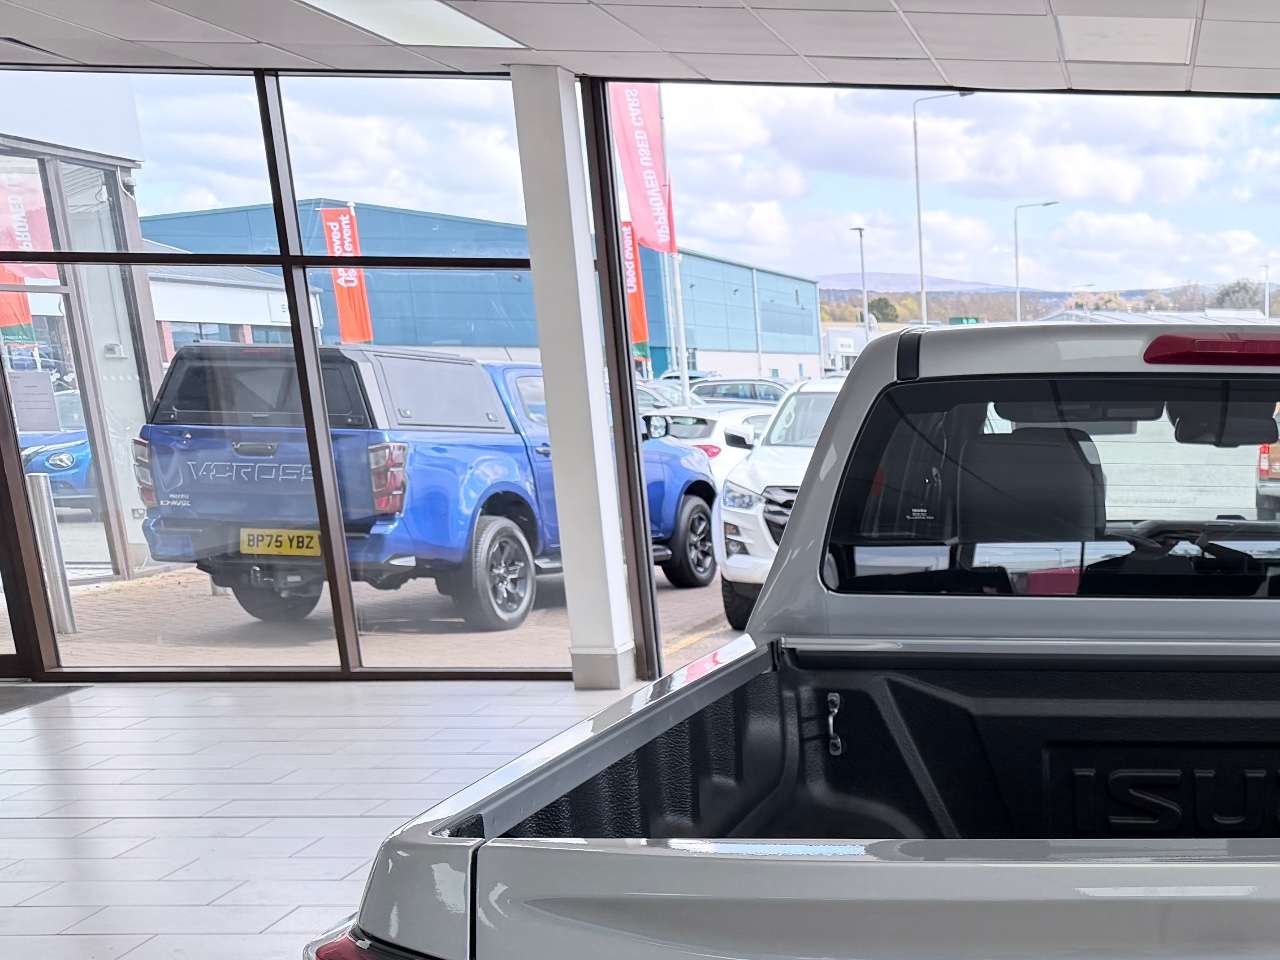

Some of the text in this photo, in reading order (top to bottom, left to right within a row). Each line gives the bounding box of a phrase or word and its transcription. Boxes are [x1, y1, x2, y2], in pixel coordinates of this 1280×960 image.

[339, 213, 354, 252] event
[327, 221, 346, 288] Apoved
[247, 533, 314, 549] BP75 YBZ
